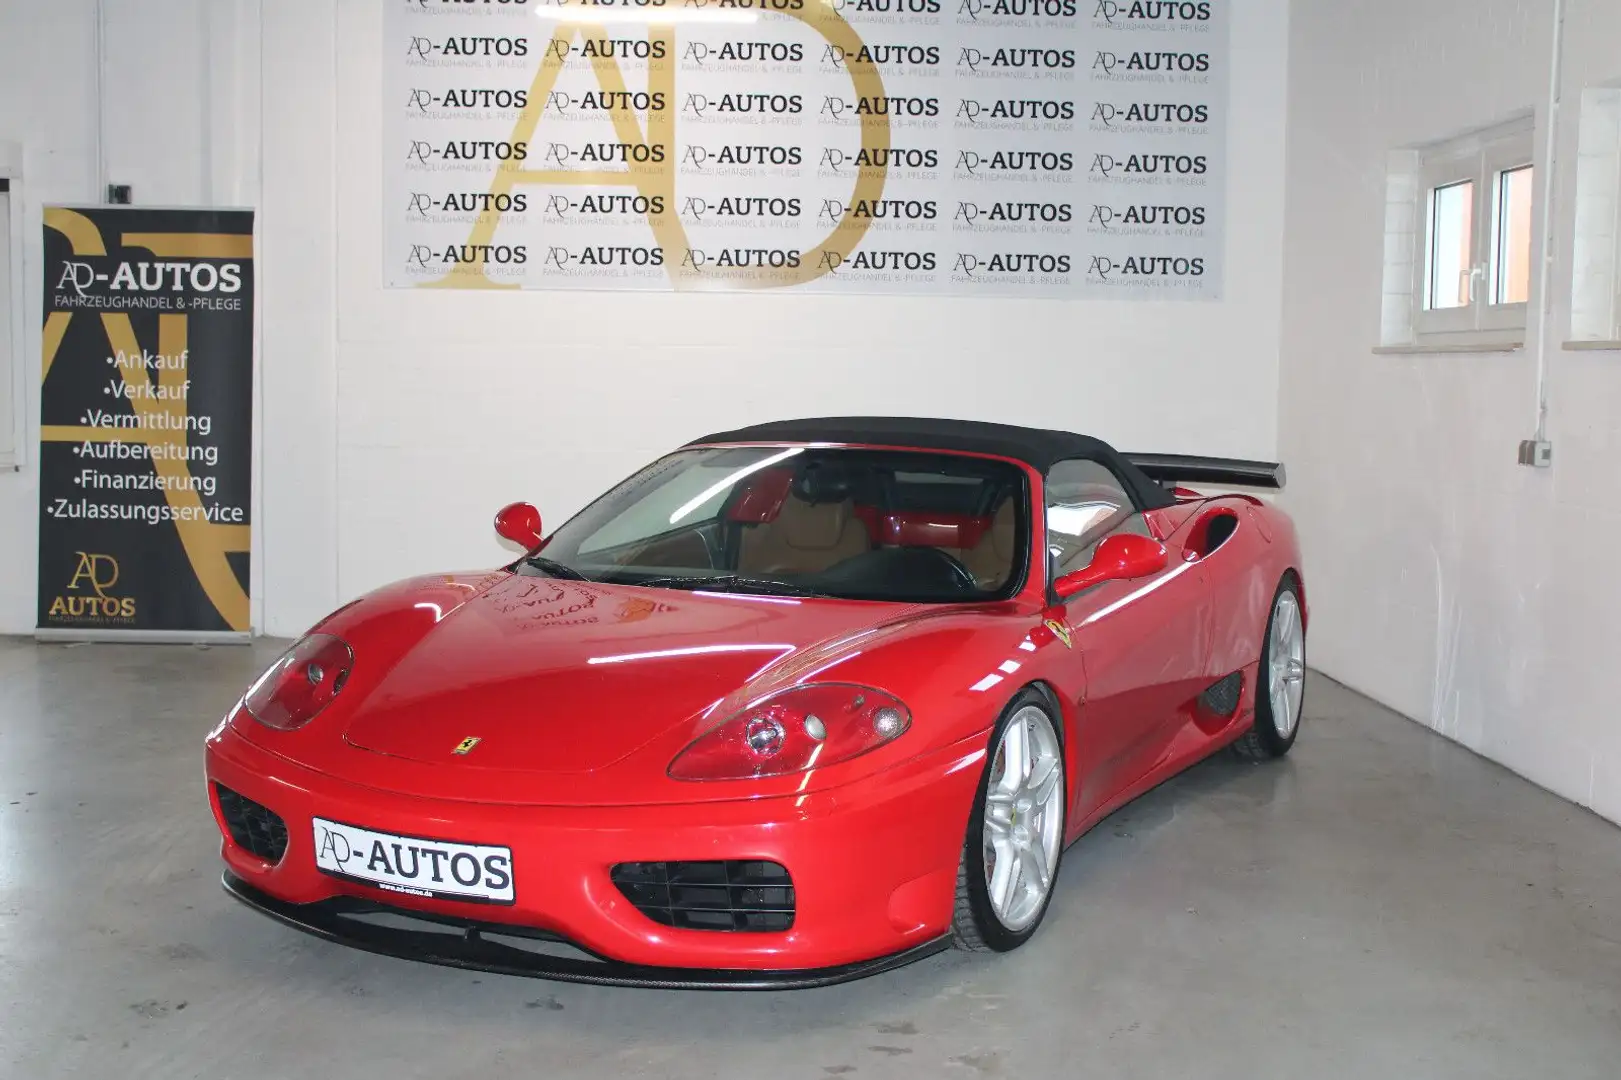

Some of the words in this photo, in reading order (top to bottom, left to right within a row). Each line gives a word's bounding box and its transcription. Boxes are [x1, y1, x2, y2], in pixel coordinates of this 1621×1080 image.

[958, 0, 1076, 20] AD-AUTOS
[1094, 0, 1210, 24] AD-AUTOS
[408, 36, 527, 62] AD-AUTOS
[544, 38, 666, 63] AD-AUTOS
[683, 41, 803, 64] AD-AUTOS
[820, 44, 940, 68] AD-AUTOS
[957, 47, 1075, 71] AD-AUTOS
[1093, 51, 1209, 75] AD-AUTOS
[407, 88, 527, 113] AD-AUTOS
[544, 90, 665, 115] AD-AUTOS
[682, 93, 802, 116] AD-AUTOS
[820, 96, 939, 119] AD-AUTOS
[956, 98, 1074, 122] AD-AUTOS
[1092, 102, 1208, 126] AD-AUTOS
[407, 140, 527, 164] AD-AUTOS
[544, 142, 665, 166] AD-AUTOS
[682, 145, 802, 168] AD-AUTOS
[819, 147, 938, 171] AD-AUTOS
[955, 150, 1073, 173] AD-AUTOS
[1090, 153, 1206, 177] AD-AUTOS
[407, 192, 527, 216] AD-AUTOS
[544, 194, 664, 218] AD-AUTOS
[682, 197, 802, 220] AD-AUTOS
[818, 198, 937, 222] AD-AUTOS
[954, 201, 1072, 225] AD-AUTOS
[1089, 204, 1205, 228] AD-AUTOS
[407, 244, 526, 268] AD-AUTOS
[544, 246, 664, 270] AD-AUTOS
[681, 248, 801, 272] AD-AUTOS
[818, 250, 936, 274] AD-AUTOS
[953, 253, 1071, 276] AD-AUTOS
[1088, 256, 1204, 279] AD-AUTOS
[56, 261, 242, 297] AD-AUTOS
[55, 295, 173, 309] FAHRZEUGHANDEL
[176, 298, 186, 309] &
[188, 297, 241, 311] -PFLEGE
[113, 350, 189, 369] Ankauf
[110, 380, 190, 400] Verkauf
[87, 409, 211, 435] Vermittlung
[80, 440, 218, 465] Aufbereitung
[81, 470, 216, 496] Finanzierung
[54, 499, 243, 524] Zulassungsservice
[49, 596, 136, 617] AUTOS
[320, 826, 510, 890] AD-AUTOS
